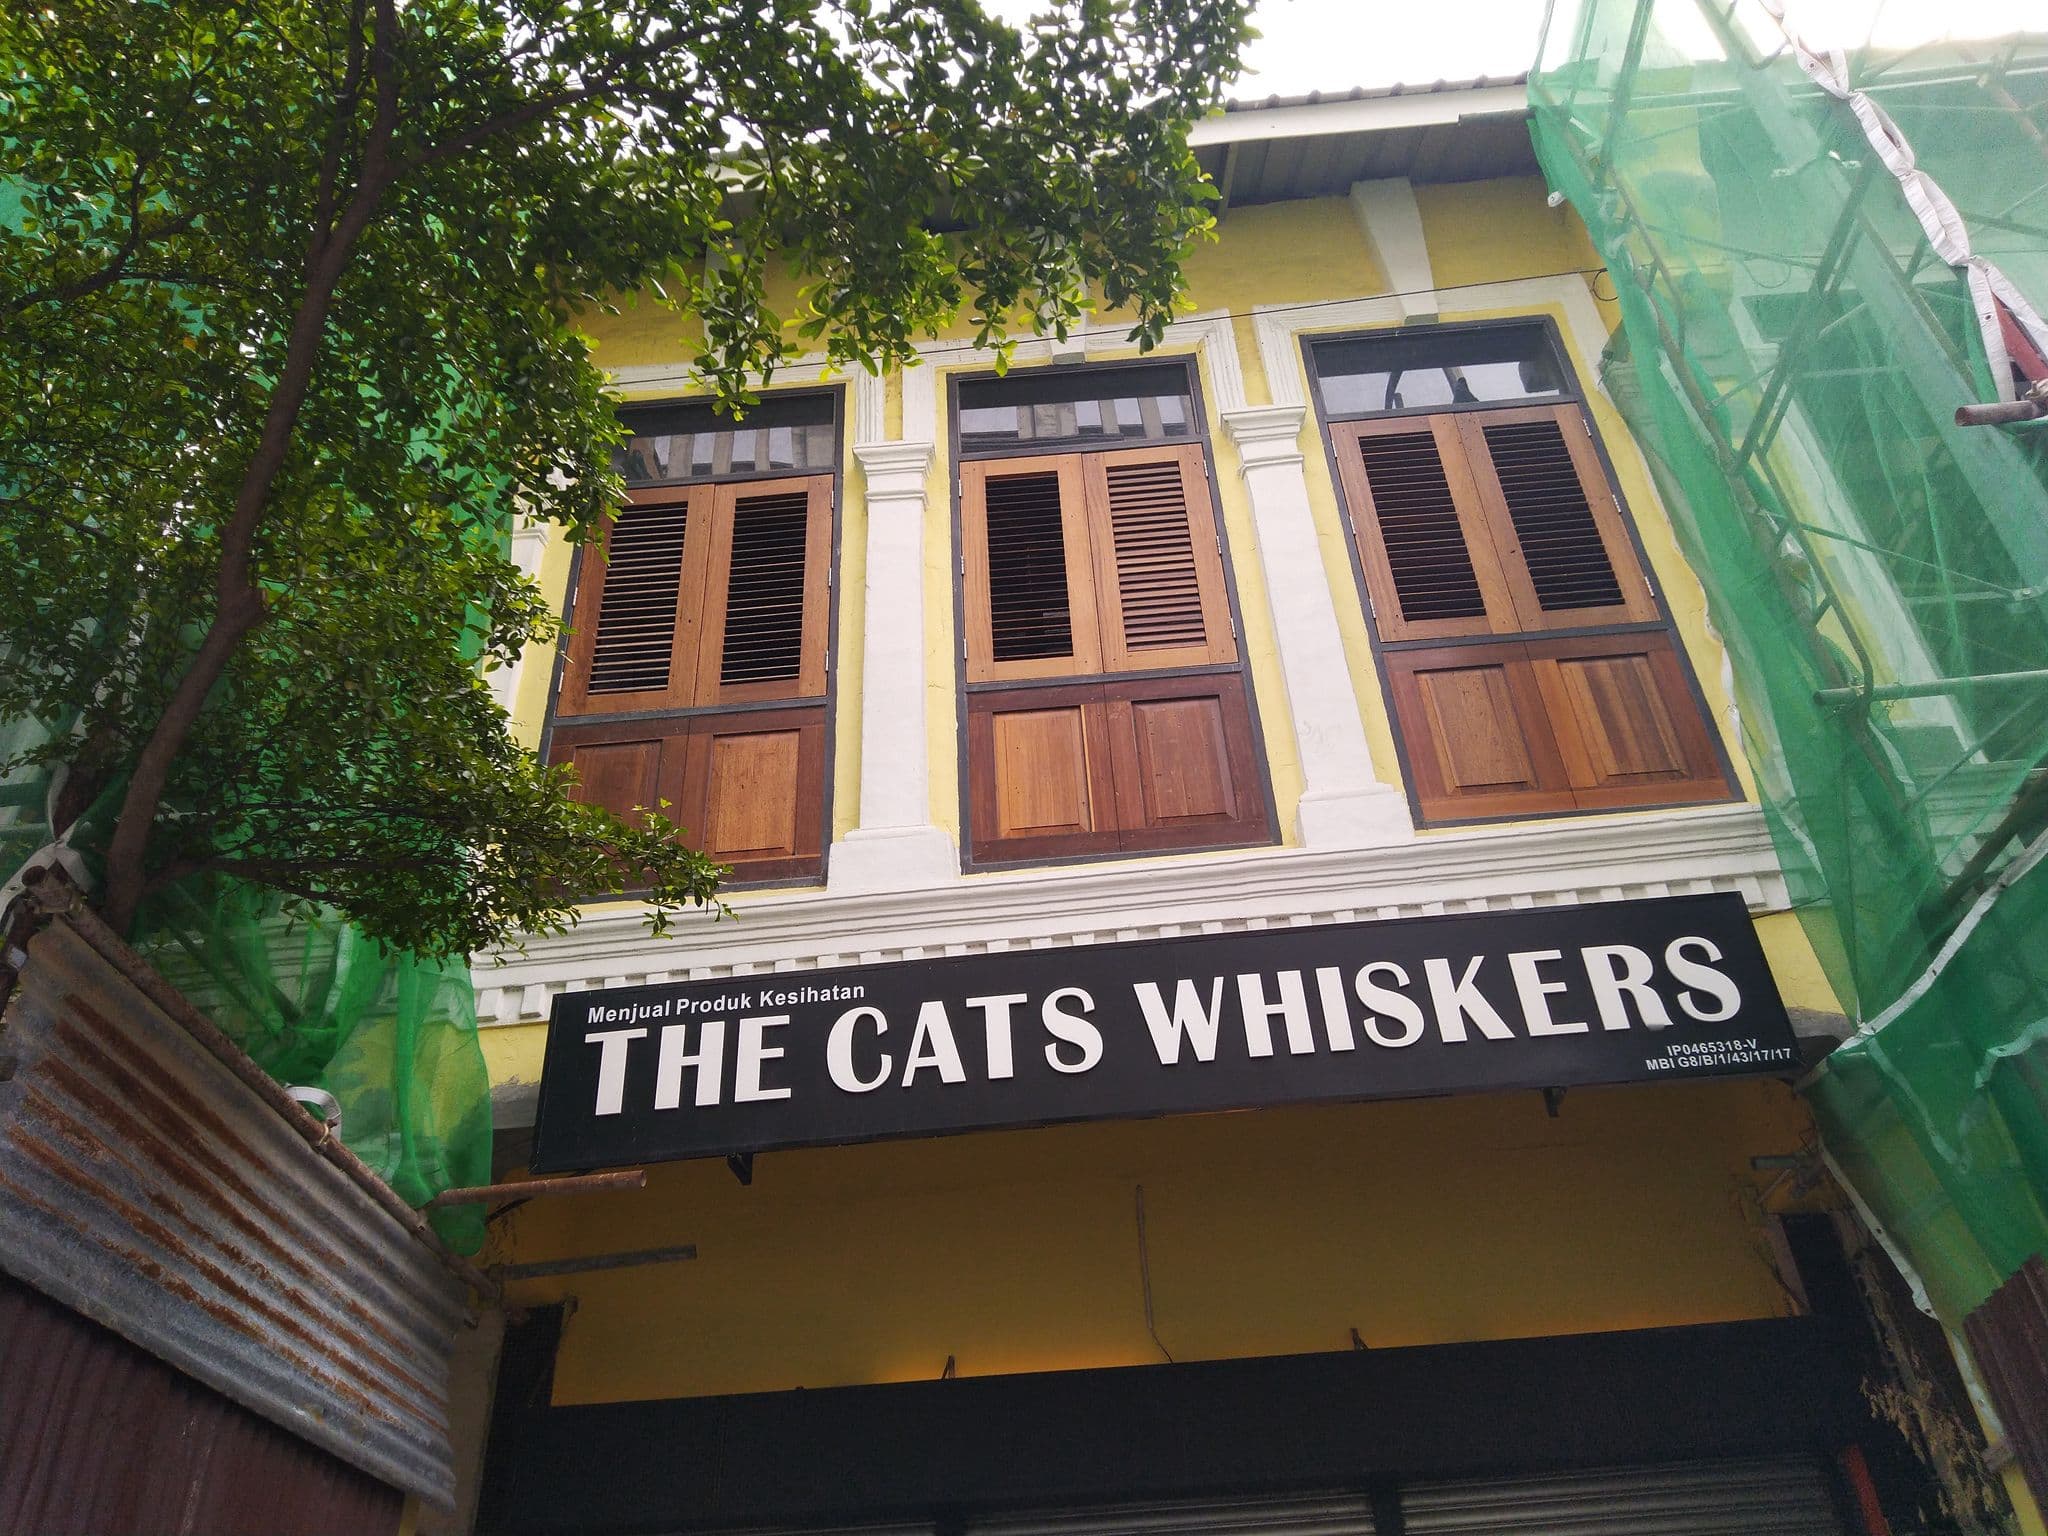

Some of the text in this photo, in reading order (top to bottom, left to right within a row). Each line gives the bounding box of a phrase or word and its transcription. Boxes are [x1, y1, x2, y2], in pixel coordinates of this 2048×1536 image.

[587, 985, 865, 1024] Menjual Produk Kesihatan
[584, 935, 1742, 1117] THE CATS WHISKERS
[1645, 1047, 1791, 1071] MBI G8/B/1/43/17/17
[1667, 1038, 1757, 1057] IP0465318-V
